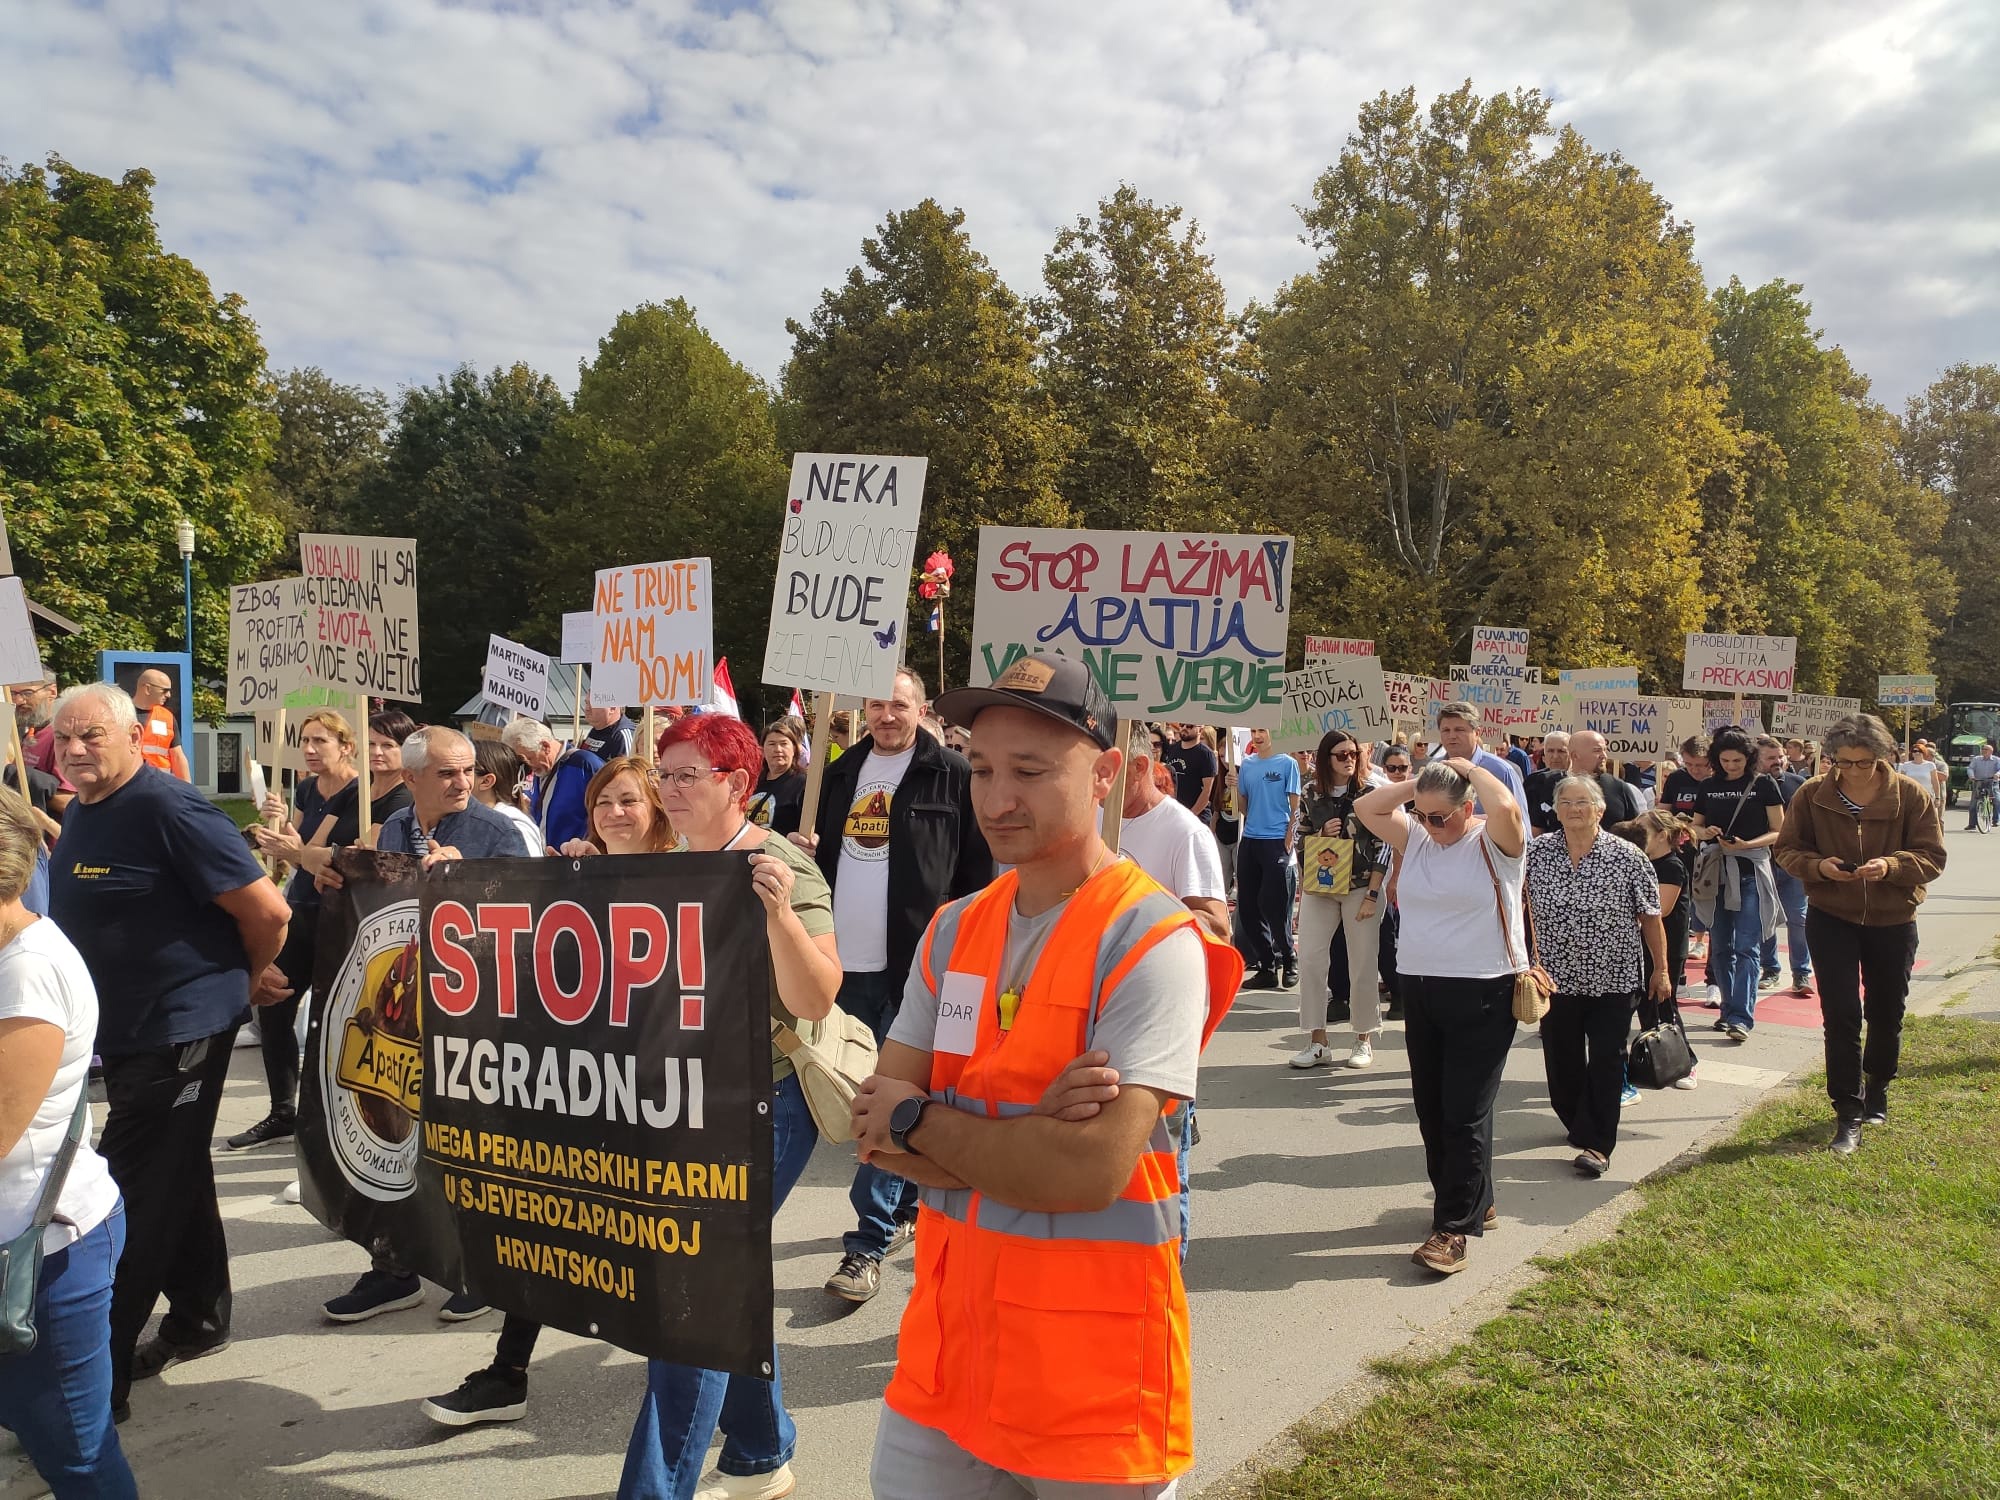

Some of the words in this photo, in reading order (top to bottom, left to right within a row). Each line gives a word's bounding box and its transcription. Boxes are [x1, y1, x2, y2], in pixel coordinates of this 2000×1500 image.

[806, 462, 899, 507] NEKA
[782, 512, 917, 571] BUDUĆNOST
[304, 543, 360, 581] UBIJAJU
[372, 548, 388, 585] IH
[393, 550, 416, 588] SA
[992, 541, 1100, 592] STOP
[237, 585, 281, 612] ZBOG
[306, 577, 317, 605] 6
[316, 578, 384, 613] TJEDANA
[597, 572, 624, 616] NE
[632, 563, 699, 615] TRUJTE
[786, 571, 885, 626] BUDE
[246, 615, 305, 642] PROFITA
[384, 617, 409, 652] NE
[601, 614, 655, 665] NAM
[1037, 593, 1285, 657] APATIJA
[237, 648, 250, 671] MI
[260, 640, 309, 672] GUBIMO
[490, 643, 546, 677] MARTINSKA
[769, 631, 875, 688] ZELENA
[1343, 639, 1376, 657] NOVCEM
[1473, 641, 1528, 655] APATIJU
[1490, 654, 1509, 665] ZA
[1692, 634, 1765, 652] PROBUDITE
[1772, 639, 1791, 652] SE
[1716, 651, 1768, 667] SUTRA
[312, 642, 348, 681] VIDE
[507, 665, 526, 683] VES
[638, 649, 704, 703] DOM!
[1702, 666, 1794, 691] PREKASNO!
[240, 676, 278, 705] DOM
[488, 678, 540, 712] MAHOVO
[1147, 655, 1285, 715] VJERUJE
[1288, 680, 1365, 713] TROVAČI
[1429, 682, 1451, 701] NE
[1484, 708, 1503, 724] NE
[1580, 699, 1658, 718] HRVATSKA
[1587, 718, 1622, 734] NIJE
[1631, 719, 1651, 734] NA
[1786, 722, 1801, 735] NE
[852, 819, 889, 834] Apatij
[428, 899, 706, 1031] STOP!
[433, 1034, 705, 1129] IZGRADNJI
[339, 1105, 359, 1144] SELO
[424, 1120, 475, 1161] MEGA
[479, 1130, 641, 1192] PERADARSKIH
[645, 1159, 748, 1201] FARMI
[443, 1172, 457, 1205] U
[459, 1176, 702, 1256] SJEVEROZAPADNOJ
[495, 1233, 637, 1301] HRVATSKOJ!
